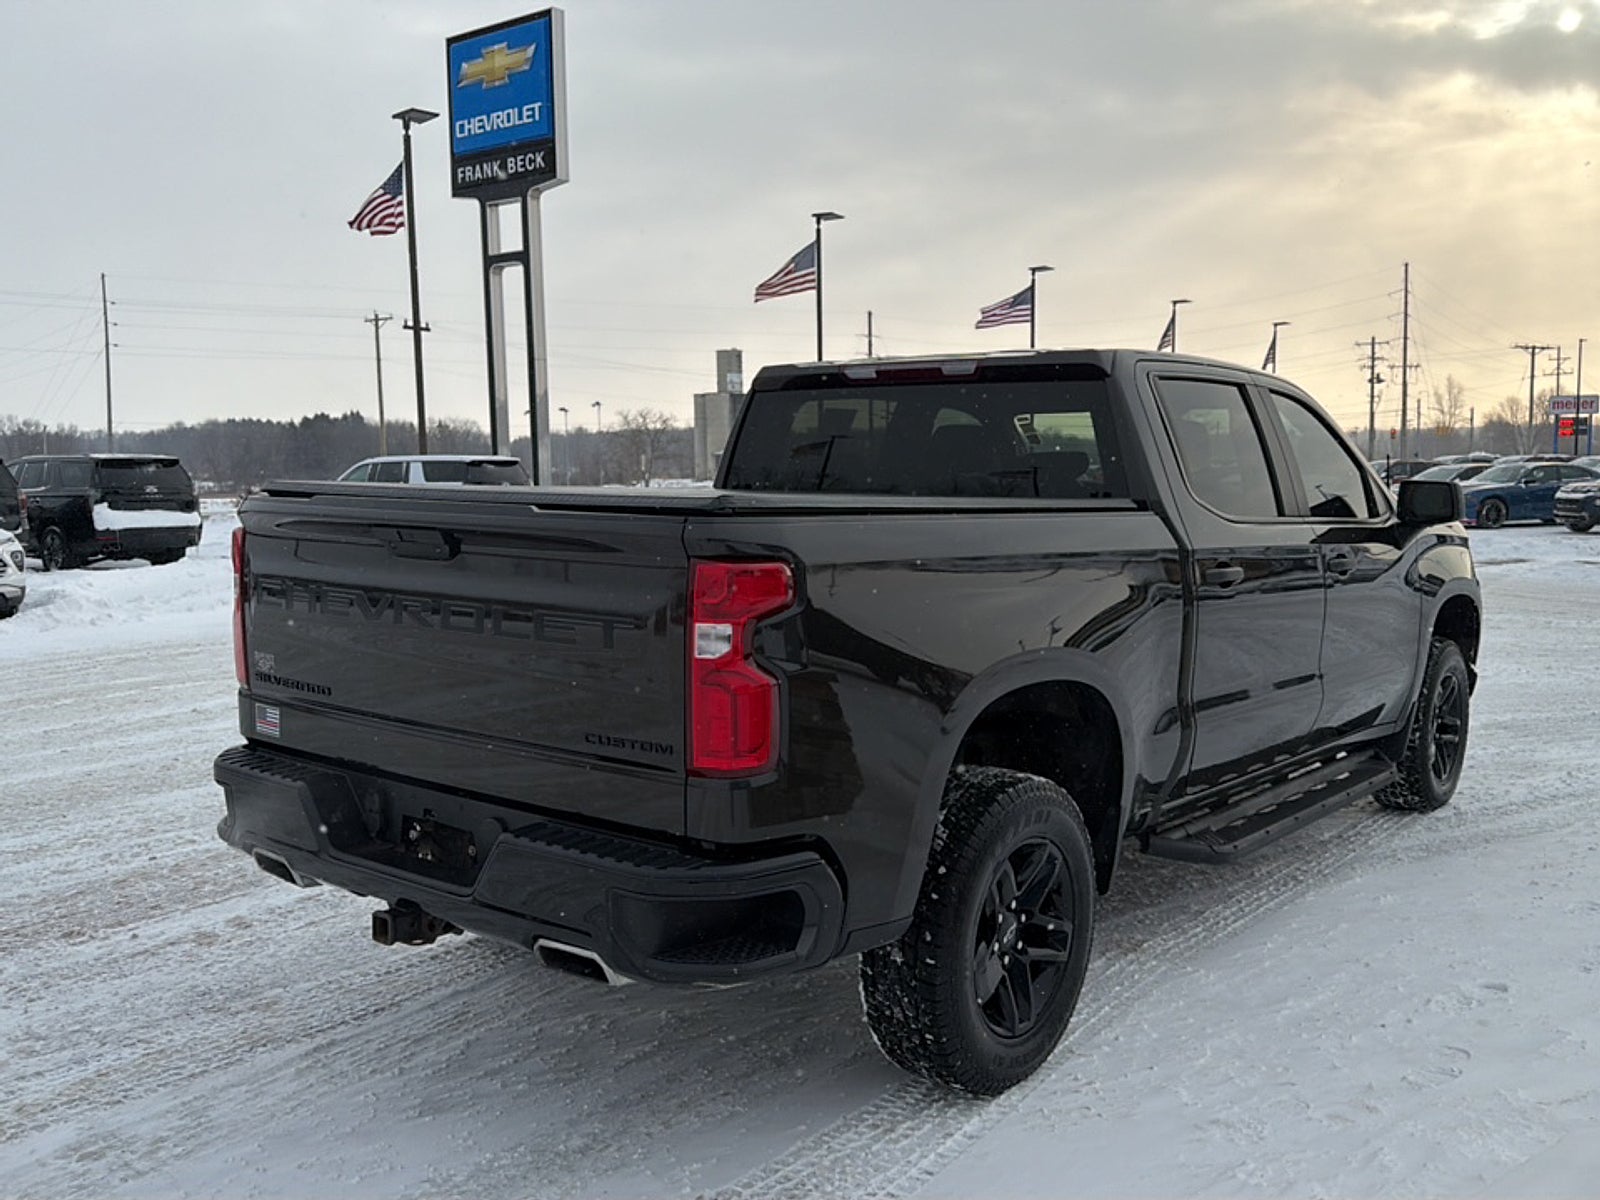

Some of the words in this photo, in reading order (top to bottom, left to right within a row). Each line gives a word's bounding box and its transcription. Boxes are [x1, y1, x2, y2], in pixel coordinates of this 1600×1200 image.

[456, 102, 542, 137] CHEVROLET
[457, 160, 501, 183] FRANK
[507, 151, 545, 173] BECK
[256, 578, 637, 649] CHEVROLET
[584, 731, 675, 756] CUSTOM
